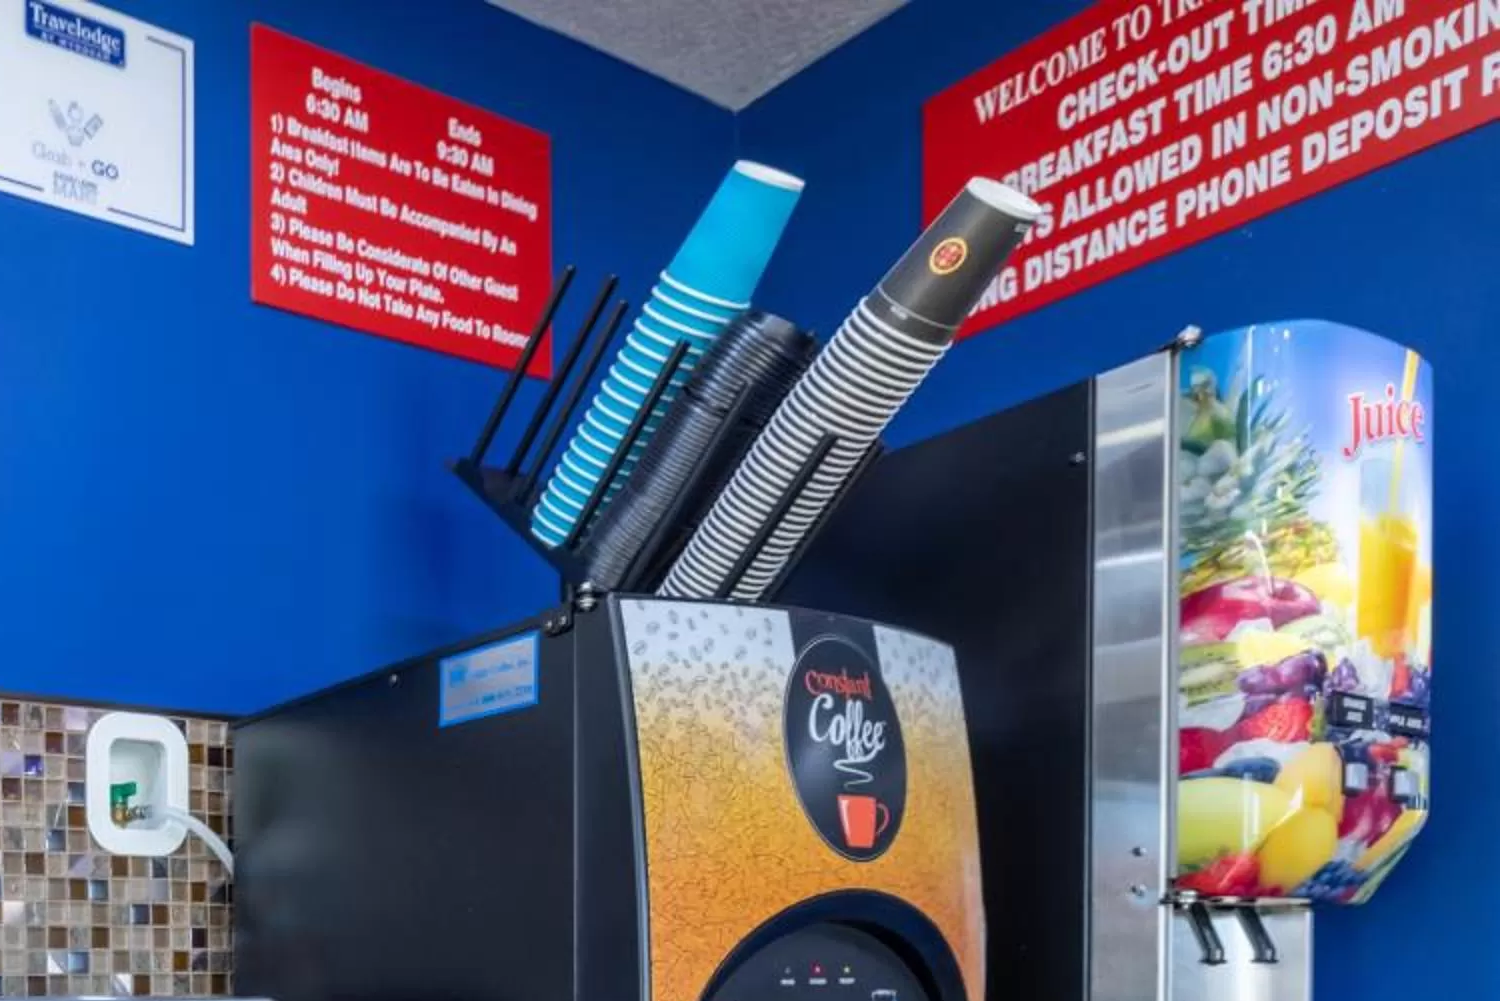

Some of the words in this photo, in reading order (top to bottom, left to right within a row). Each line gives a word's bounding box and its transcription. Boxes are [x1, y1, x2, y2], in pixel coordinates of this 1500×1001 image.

[29, 2, 121, 58] Travelodge
[973, 27, 1108, 125] WELCOME
[1112, 4, 1150, 51] TO
[1174, 53, 1253, 123] TIME
[1262, 14, 1336, 82] 6:30
[1347, 0, 1405, 42] AM
[311, 66, 361, 103] Begins
[1057, 10, 1235, 130] CHECK-OUT
[305, 92, 341, 123] 6:30
[343, 106, 369, 133] AM
[448, 116, 483, 147] Ends
[91, 159, 119, 180] GO
[270, 136, 303, 164] Area
[304, 147, 340, 178] Only!
[270, 111, 284, 134] 1)
[286, 116, 348, 155] Breakfast
[389, 152, 412, 177] Are
[414, 159, 431, 182] To
[431, 167, 450, 190] Be
[500, 189, 538, 222] Dining
[436, 139, 469, 168] 9:30
[470, 150, 495, 177] AM
[1023, 199, 1168, 292] DISTANCE
[1175, 144, 1292, 228] PHONE
[1302, 65, 1470, 175] DEPOSIT
[1059, 133, 1203, 229] ALLOWED
[1211, 111, 1247, 160] IN
[269, 161, 285, 184] 2)
[287, 166, 344, 201] Children
[344, 185, 378, 214] Must
[379, 195, 399, 220] Be
[399, 203, 481, 246] Accompanied
[481, 228, 499, 255] By
[499, 235, 517, 257] An
[270, 186, 308, 216] Adult
[270, 211, 286, 236] 3)
[288, 216, 334, 248] Please
[336, 231, 355, 254] Be
[357, 237, 431, 278] Considerate
[432, 260, 449, 281] Of
[449, 265, 483, 291] Other
[483, 276, 519, 303] Guest
[270, 235, 310, 265] When
[311, 248, 353, 281] Filling
[355, 260, 375, 287] Up
[376, 267, 408, 294] Your
[269, 262, 287, 288] 4)
[288, 267, 334, 298] Please
[336, 280, 356, 304] Do
[357, 286, 382, 312] Not
[383, 293, 415, 320] Take
[415, 302, 440, 331] Any
[441, 309, 474, 336] Food
[475, 318, 491, 339] To
[1341, 382, 1425, 461] Juice
[808, 692, 886, 764] Coffee
